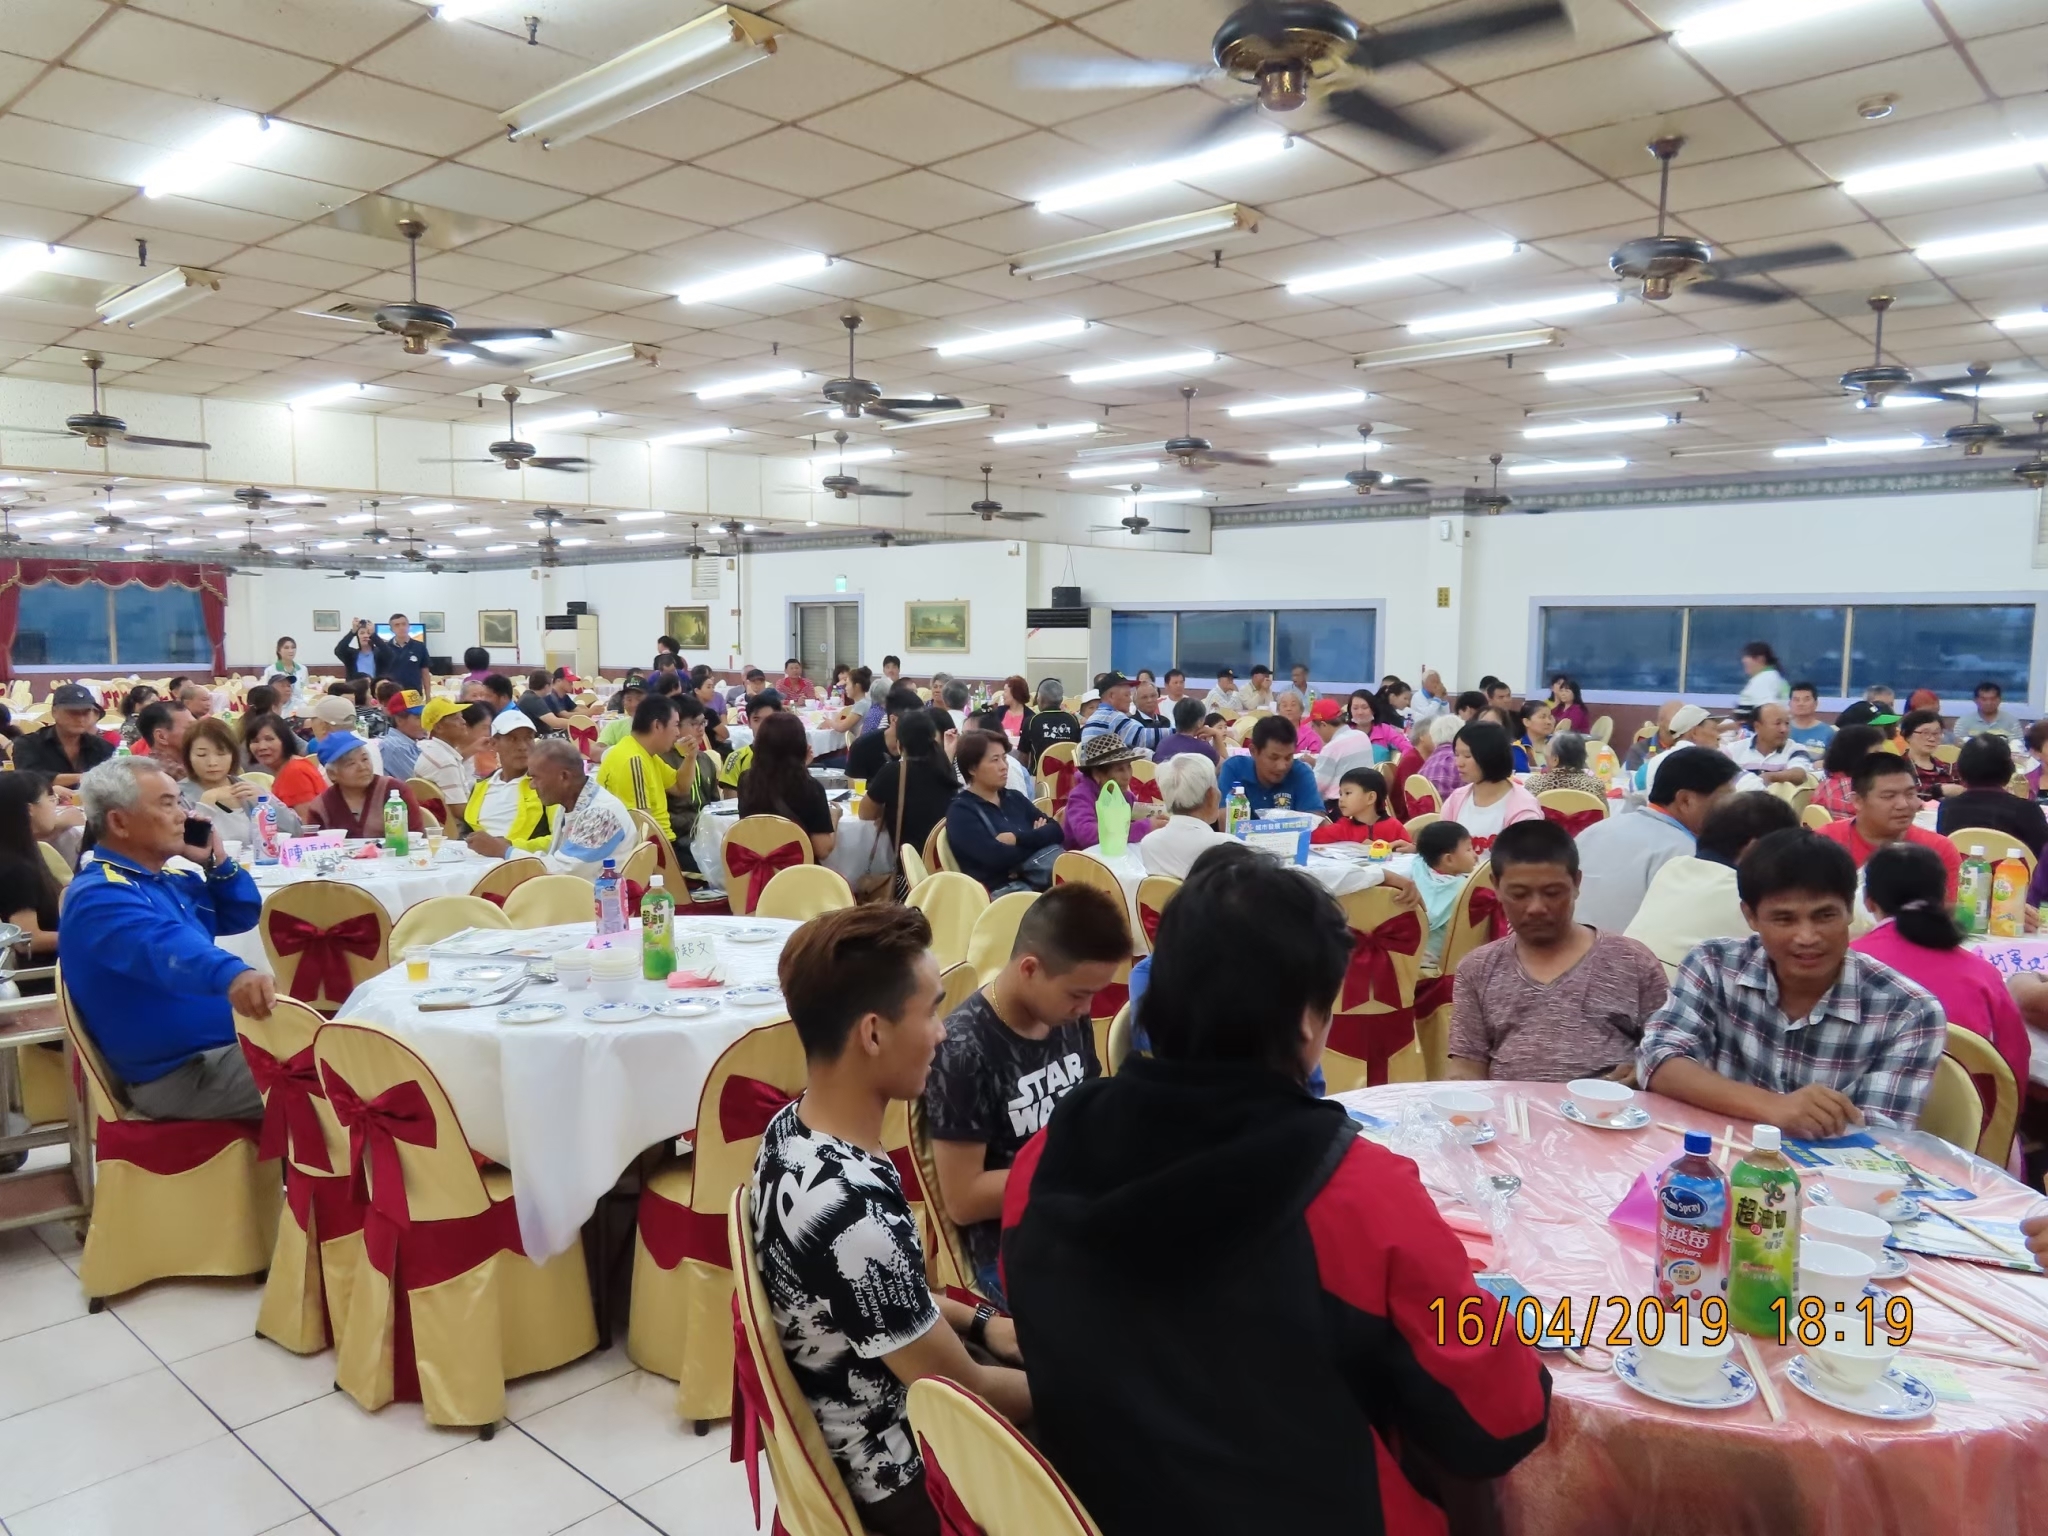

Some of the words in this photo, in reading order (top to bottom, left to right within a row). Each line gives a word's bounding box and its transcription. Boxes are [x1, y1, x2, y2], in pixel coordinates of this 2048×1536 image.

[1008, 1053, 1084, 1111] STAR
[1008, 1086, 1073, 1137] WA
[1678, 1203, 1700, 1214] Spray
